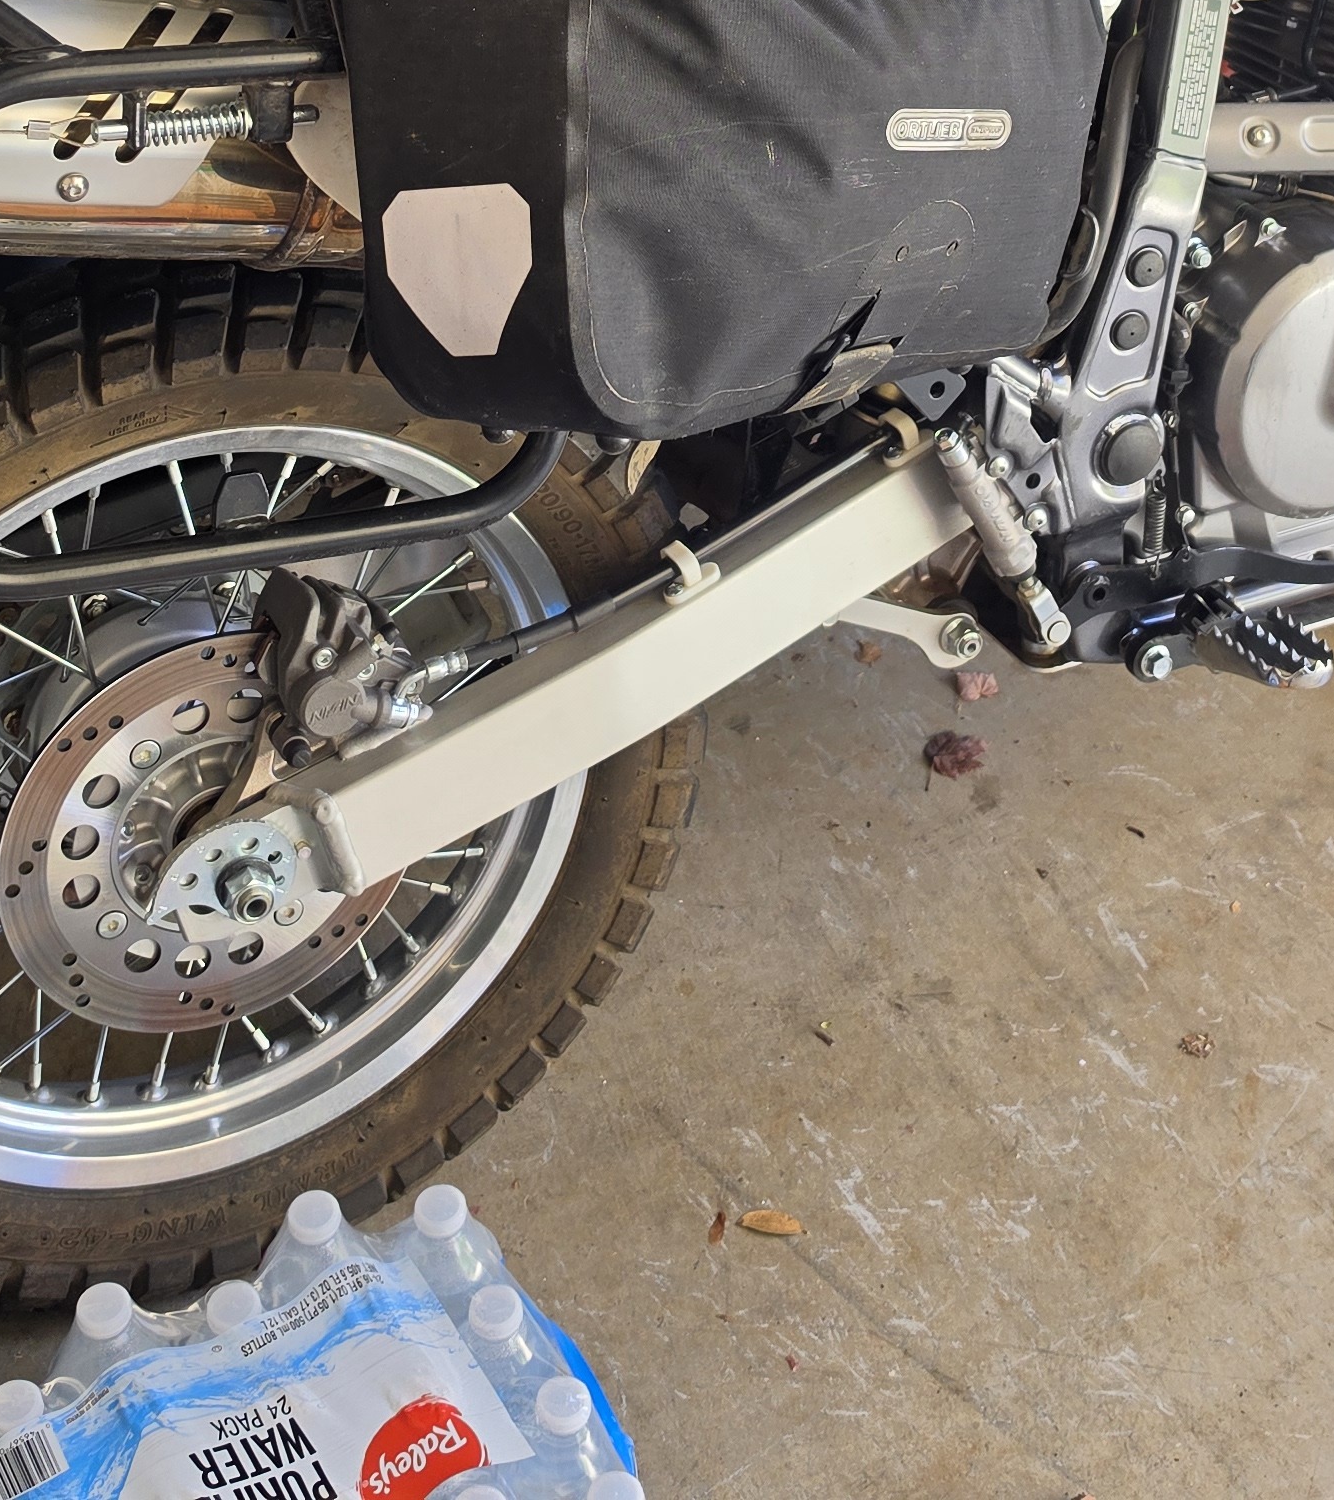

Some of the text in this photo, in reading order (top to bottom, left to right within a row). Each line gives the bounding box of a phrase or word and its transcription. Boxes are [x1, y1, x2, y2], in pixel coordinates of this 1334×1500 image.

[896, 120, 961, 141] ORTLIEB
[253, 1148, 362, 1211] TRAIL
[329, 1273, 342, 1285] FL
[341, 1262, 362, 1281] 405.6
[318, 1279, 332, 1292] OZ
[299, 1286, 322, 1313] (3.17
[268, 1314, 279, 1328] 12
[278, 1305, 300, 1323] GAL)
[291, 1315, 306, 1331] 500
[260, 1320, 269, 1331] L
[279, 1323, 291, 1337] mL
[240, 1328, 278, 1358] BOTTLES
[209, 1394, 293, 1442] 24 PACK
[188, 1417, 318, 1490] WATER
[368, 1418, 468, 1495] Raley's
